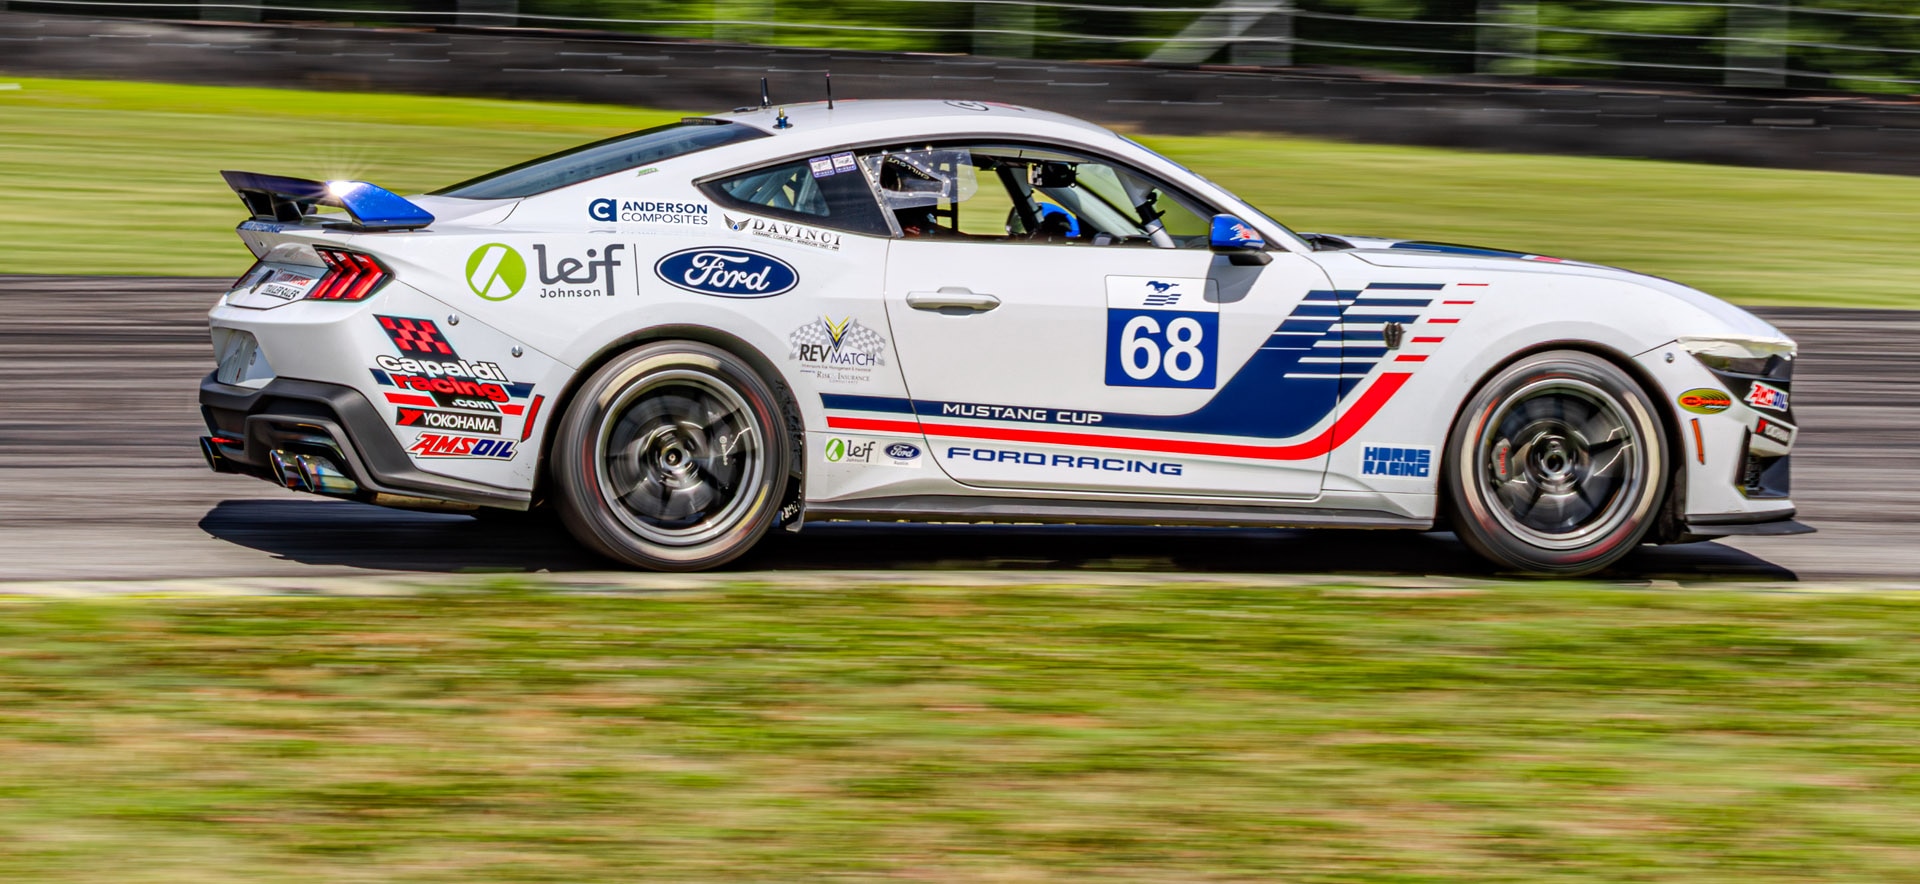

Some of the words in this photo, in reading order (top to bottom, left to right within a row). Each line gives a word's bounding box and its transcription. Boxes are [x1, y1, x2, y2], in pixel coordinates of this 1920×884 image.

[621, 212, 708, 225] COMPOSITES
[622, 201, 708, 214] ANDERSON
[752, 218, 841, 245] DAVINCI
[773, 234, 793, 243] COATING
[797, 238, 818, 247] WINDOW
[532, 243, 625, 296] leif
[685, 252, 772, 292] Ford
[540, 287, 601, 298] Johnson
[1119, 314, 1205, 382] 68
[376, 354, 509, 382] capaldi
[389, 373, 510, 403] racing
[452, 399, 495, 410] .com
[942, 403, 1047, 421] MUSTANG
[1056, 410, 1103, 425] CUP
[424, 412, 498, 432] YOKOHAMA
[408, 433, 515, 458] AMSOIL
[847, 440, 876, 463] leif
[890, 444, 914, 457] Ford
[1364, 446, 1432, 463] HOROS
[947, 446, 1050, 466] FORD
[1051, 453, 1184, 476] RACING
[1362, 460, 1430, 477] RACING
